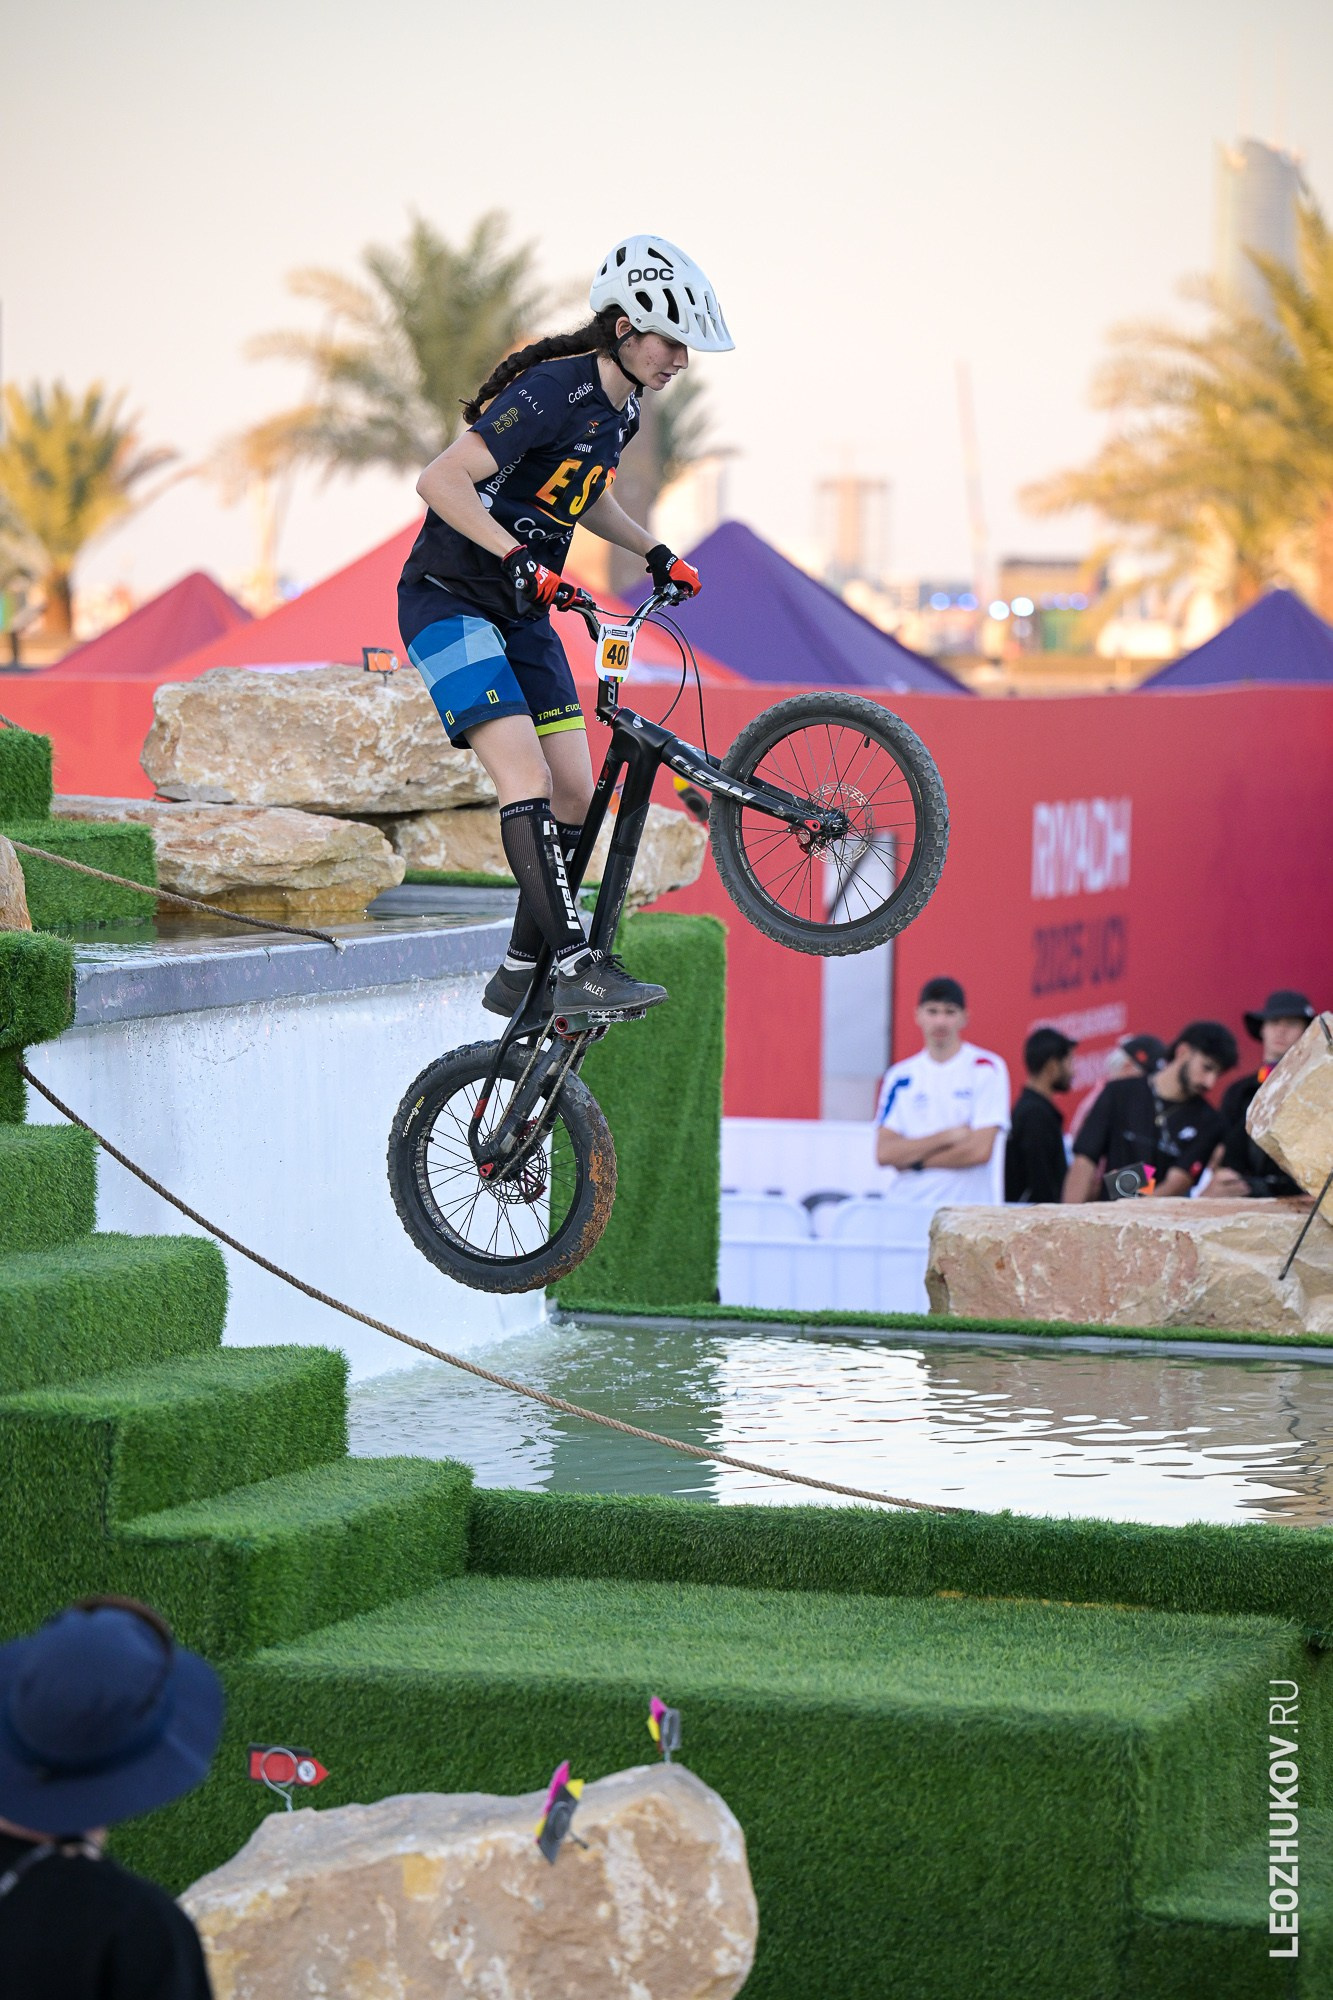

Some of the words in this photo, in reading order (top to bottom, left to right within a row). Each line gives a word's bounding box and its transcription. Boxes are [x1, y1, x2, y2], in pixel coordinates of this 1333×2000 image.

[568, 382, 594, 404] Cofidis
[491, 407, 519, 434] ESP
[537, 707, 563, 721] TRIAL
